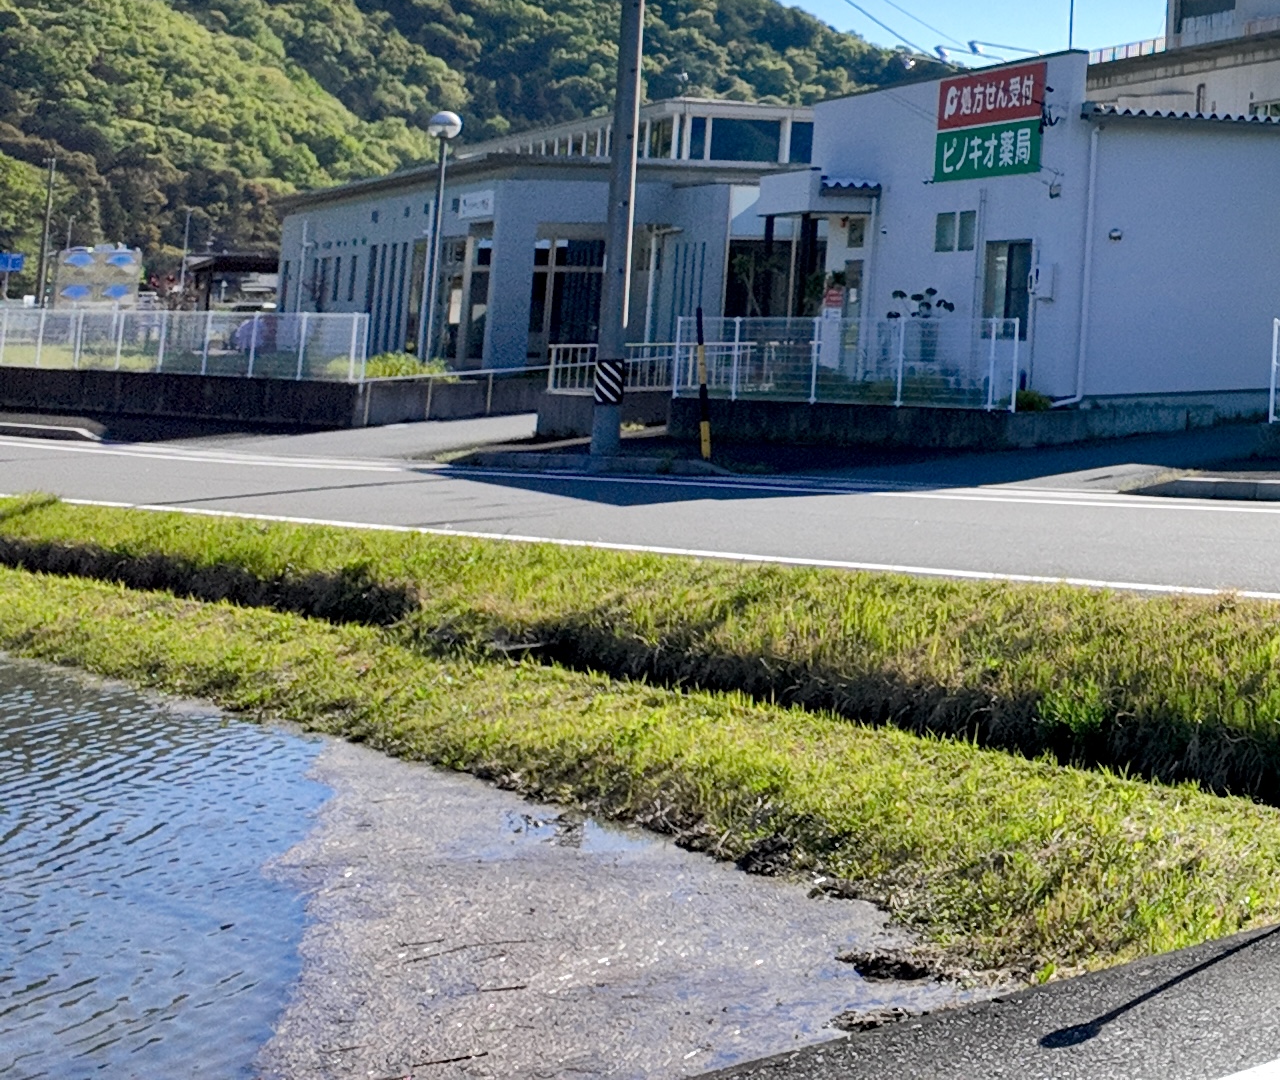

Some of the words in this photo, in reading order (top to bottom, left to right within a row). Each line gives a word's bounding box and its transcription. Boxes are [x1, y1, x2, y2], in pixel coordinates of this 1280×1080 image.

[960, 74, 1034, 115] 処方せん受付
[943, 128, 1031, 173] ピノキオ薬局
